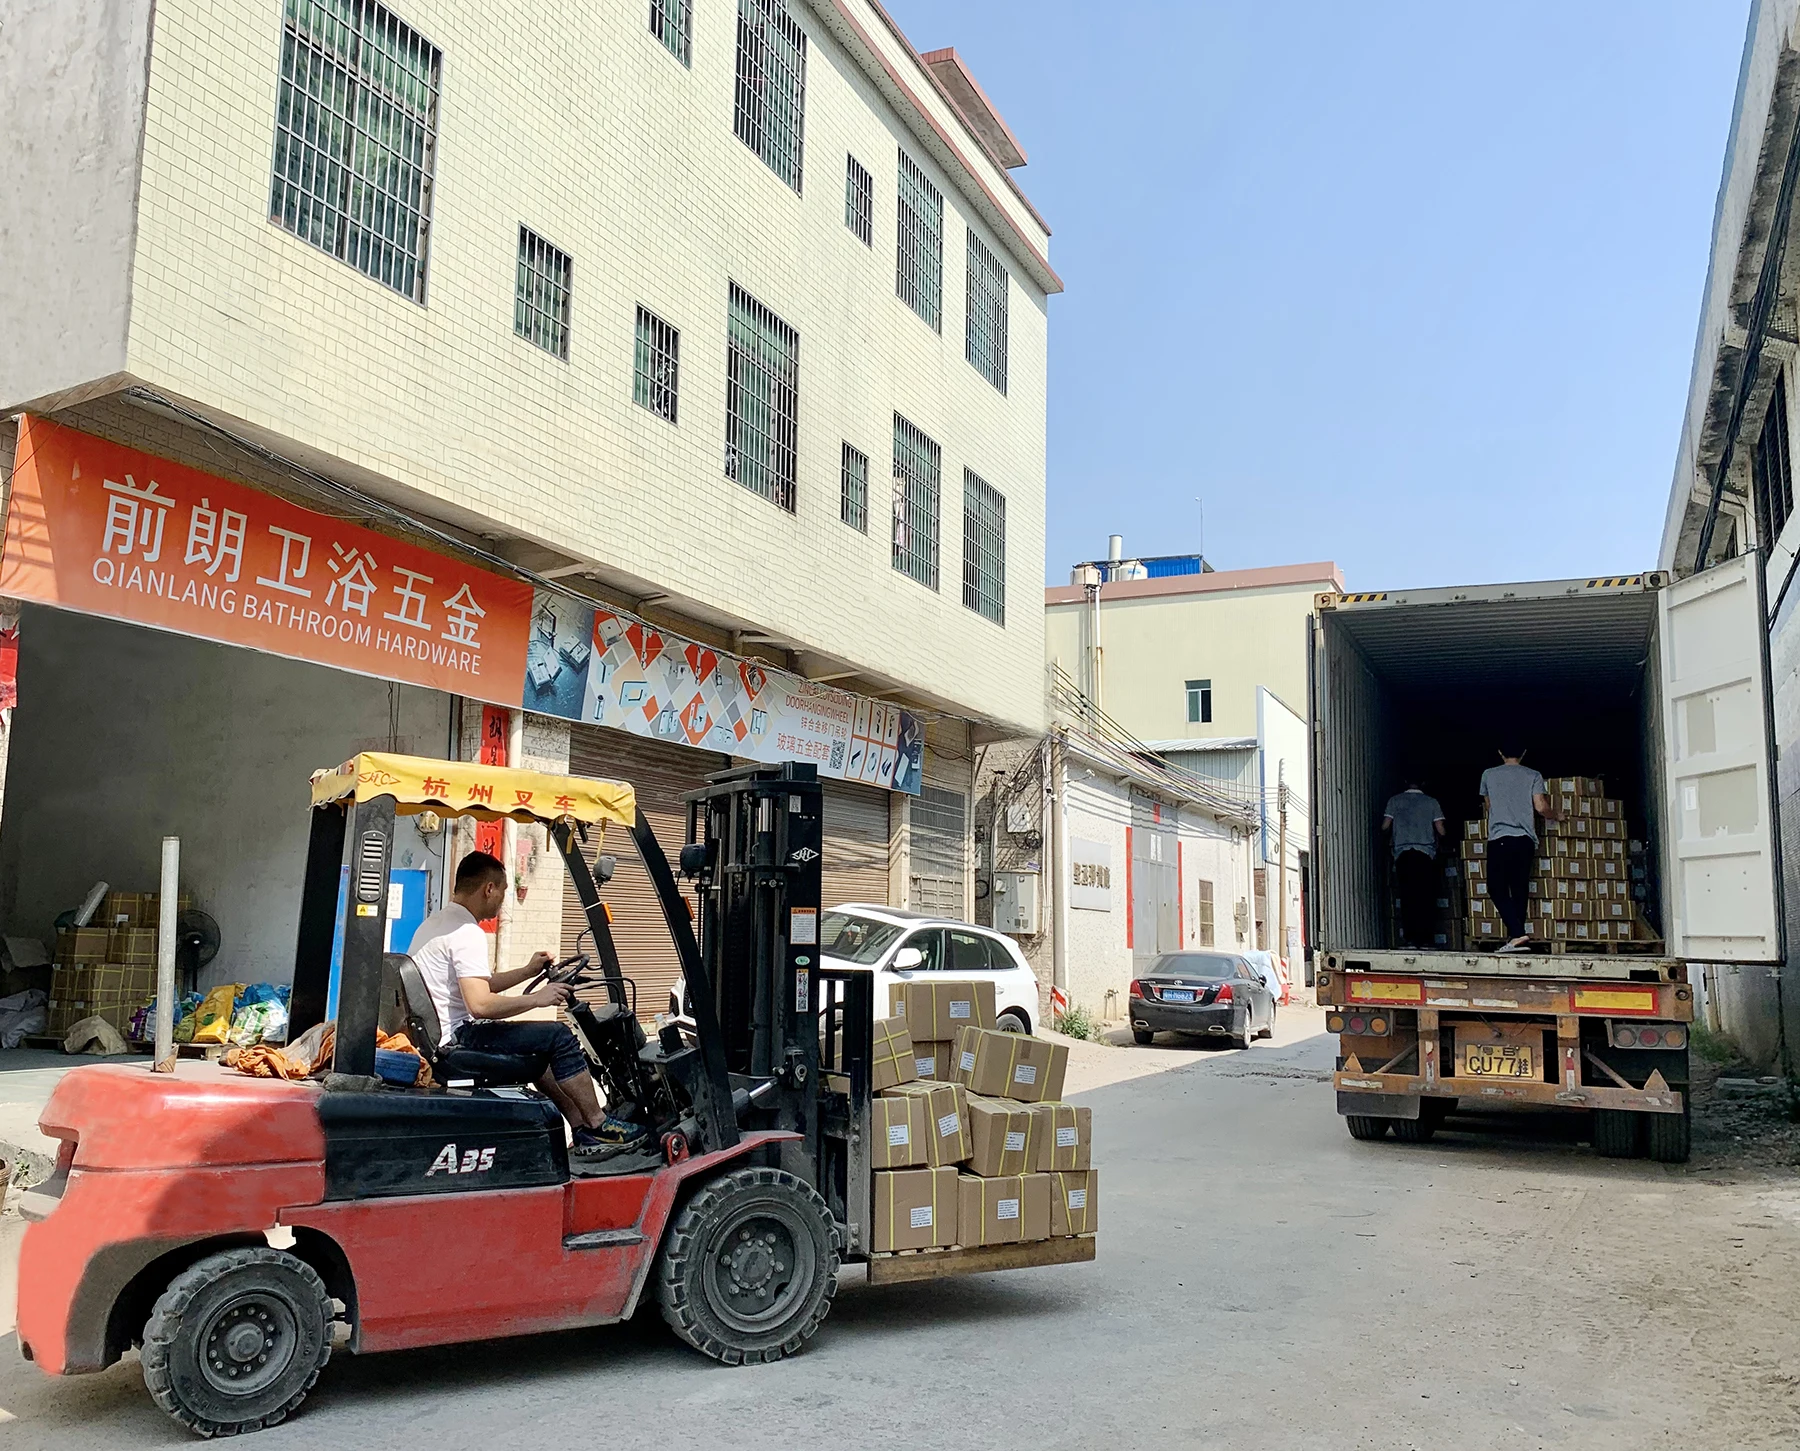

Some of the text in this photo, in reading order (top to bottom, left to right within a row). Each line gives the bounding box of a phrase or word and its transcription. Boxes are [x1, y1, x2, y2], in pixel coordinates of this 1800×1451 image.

[101, 473, 487, 649] 前朗卫浴五金
[93, 557, 482, 676] QIANLANG BATHROOM HARDWARE
[776, 732, 831, 761] 玻璃五金配套
[422, 776, 578, 814] 杭州叉车
